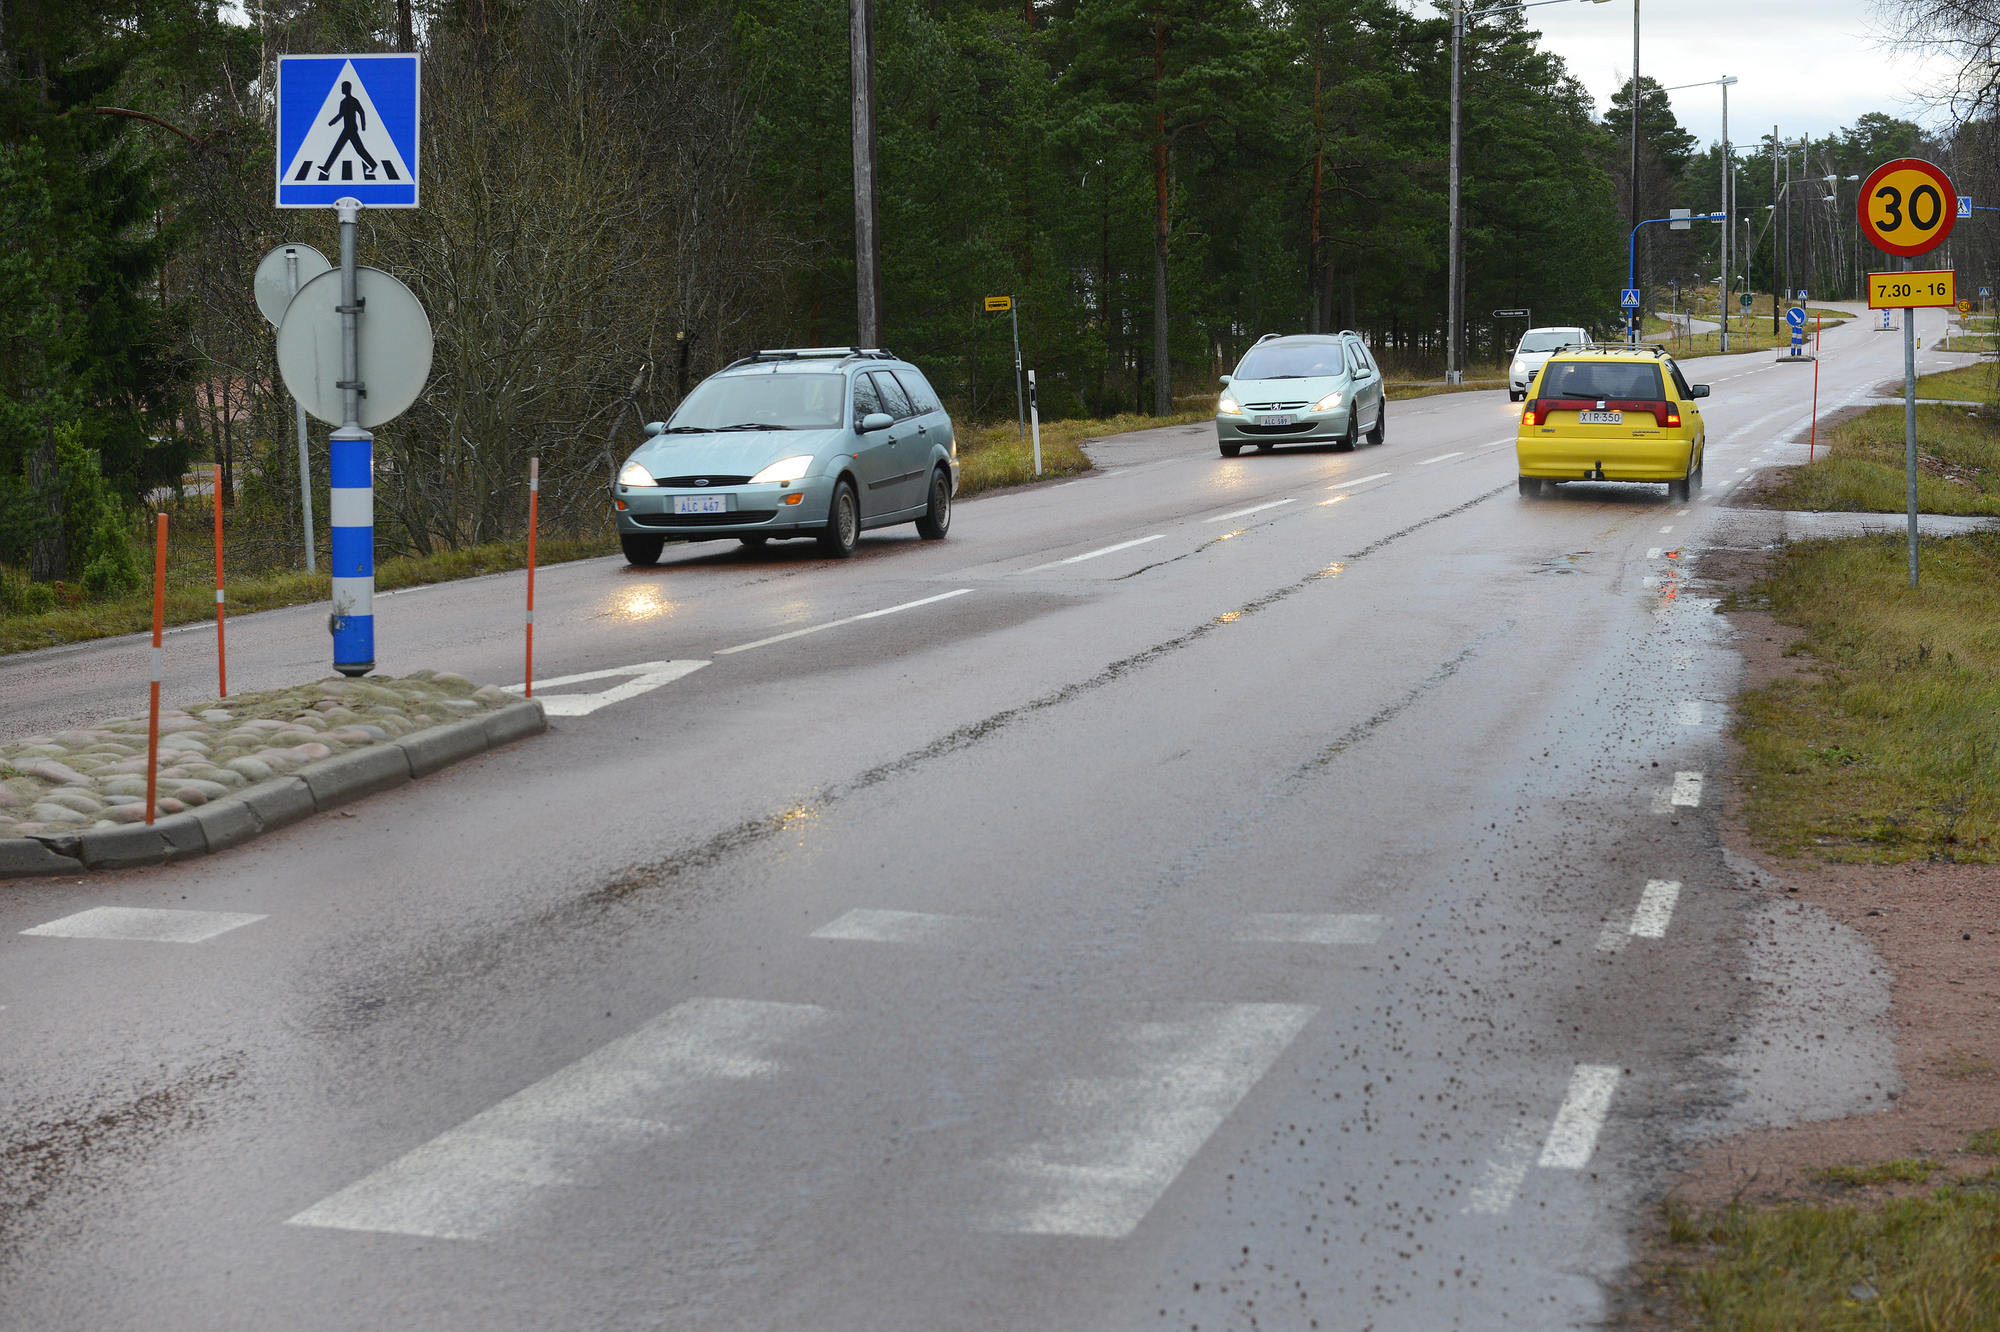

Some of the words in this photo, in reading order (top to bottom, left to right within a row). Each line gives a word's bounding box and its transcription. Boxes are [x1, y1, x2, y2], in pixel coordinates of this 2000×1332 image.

[1875, 184, 1942, 232] 30
[1877, 284, 1911, 298] 7.30
[1927, 282, 1946, 296] 16
[1960, 302, 1969, 310] 50
[1581, 412, 1620, 422] XIR-350
[703, 501, 720, 512] 467
